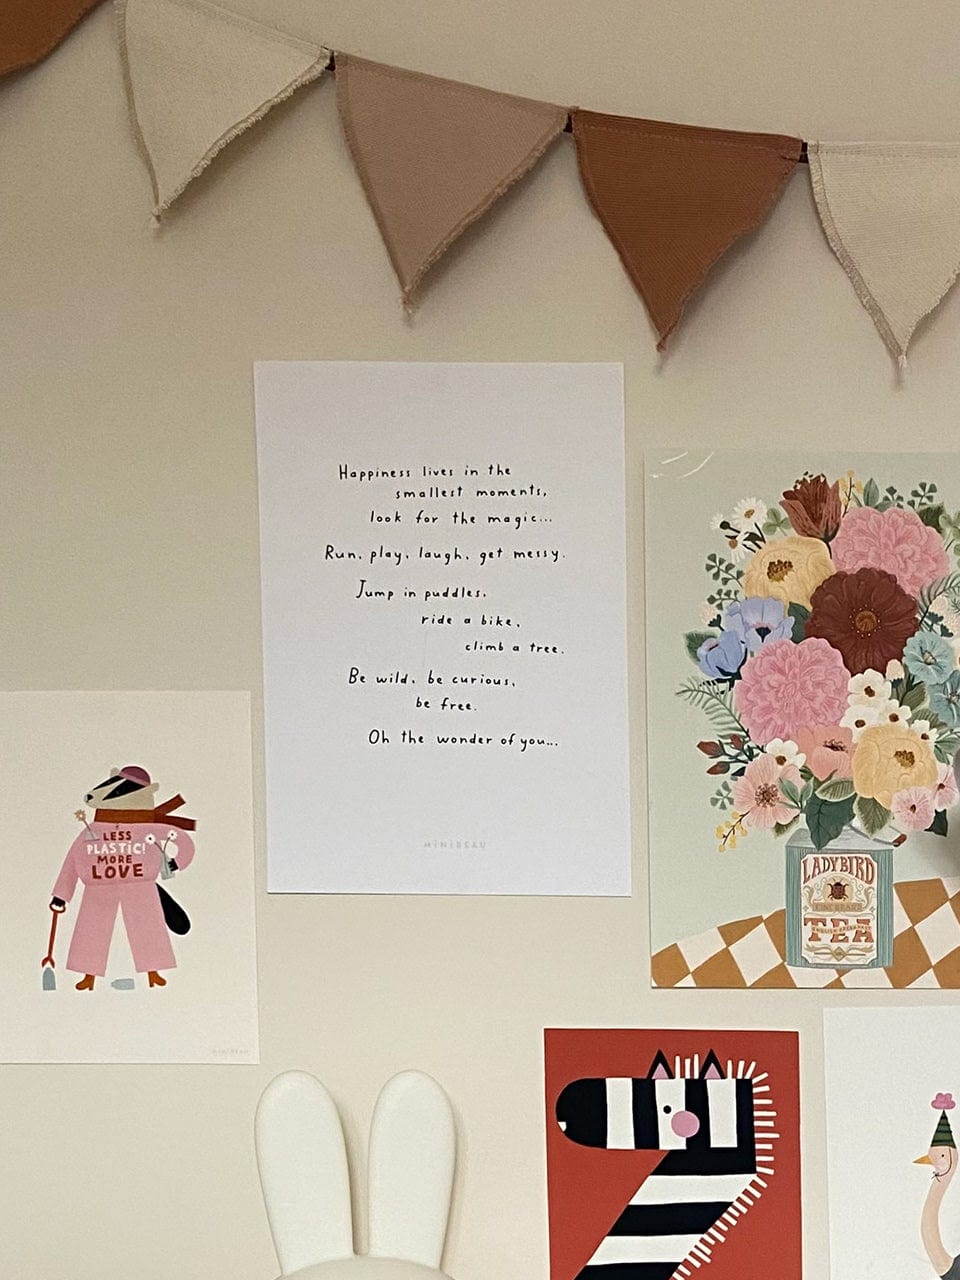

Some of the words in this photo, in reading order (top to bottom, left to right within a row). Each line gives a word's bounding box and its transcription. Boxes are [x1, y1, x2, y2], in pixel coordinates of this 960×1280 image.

[339, 464, 410, 481] Happiness
[423, 466, 453, 476] lives
[465, 465, 478, 476] in
[488, 464, 511, 475] the
[396, 486, 462, 499] smallest
[371, 510, 401, 522] look
[416, 510, 438, 523] for
[453, 511, 475, 525] the
[480, 547, 503, 566] get
[356, 579, 393, 600] Jump
[404, 587, 416, 597] in
[422, 614, 452, 624] ride
[465, 641, 503, 651] climb
[349, 667, 365, 684] Be
[428, 670, 442, 684] be
[416, 696, 430, 708] be
[369, 729, 389, 744] Oh
[401, 730, 424, 744] the
[437, 733, 492, 744] wonder
[501, 733, 516, 745] of
[103, 831, 132, 841] LESS
[97, 855, 133, 865] MORE
[92, 863, 144, 879] LOVE
[802, 856, 875, 885] LADYBIRD
[804, 917, 874, 943] TEA
